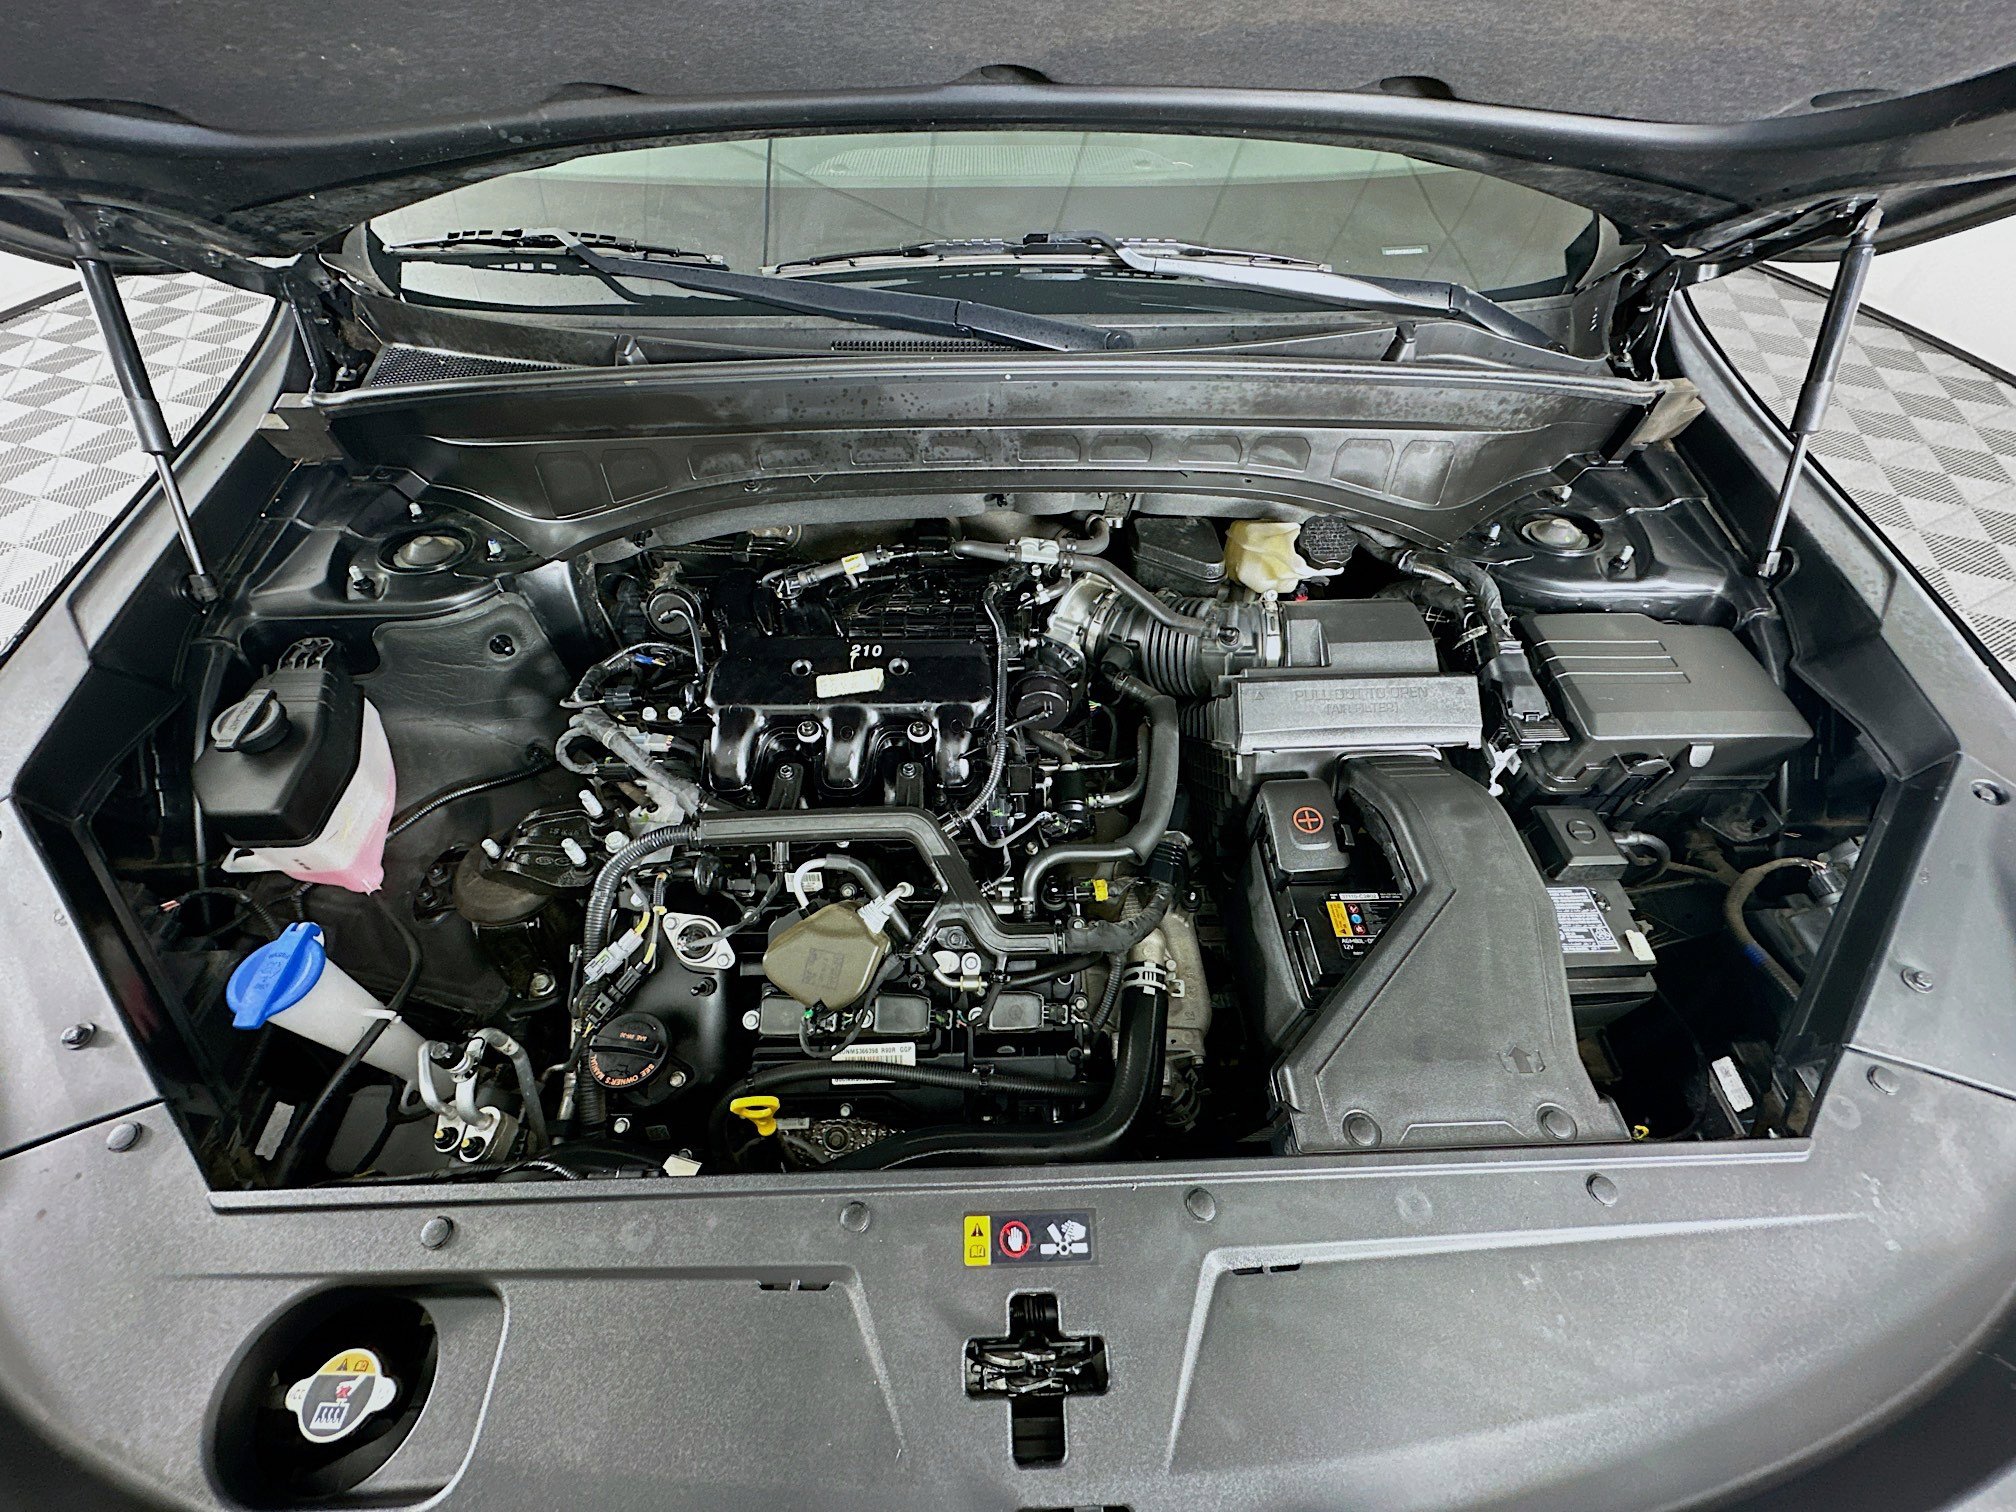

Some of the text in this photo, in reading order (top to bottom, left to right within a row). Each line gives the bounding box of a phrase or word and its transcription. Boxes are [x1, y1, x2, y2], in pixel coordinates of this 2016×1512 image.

[850, 644, 882, 657] 210
[1293, 685, 1429, 701] PULL OUT TO OPEN
[590, 1054, 655, 1086] SEE OWNER'S MANUAL
